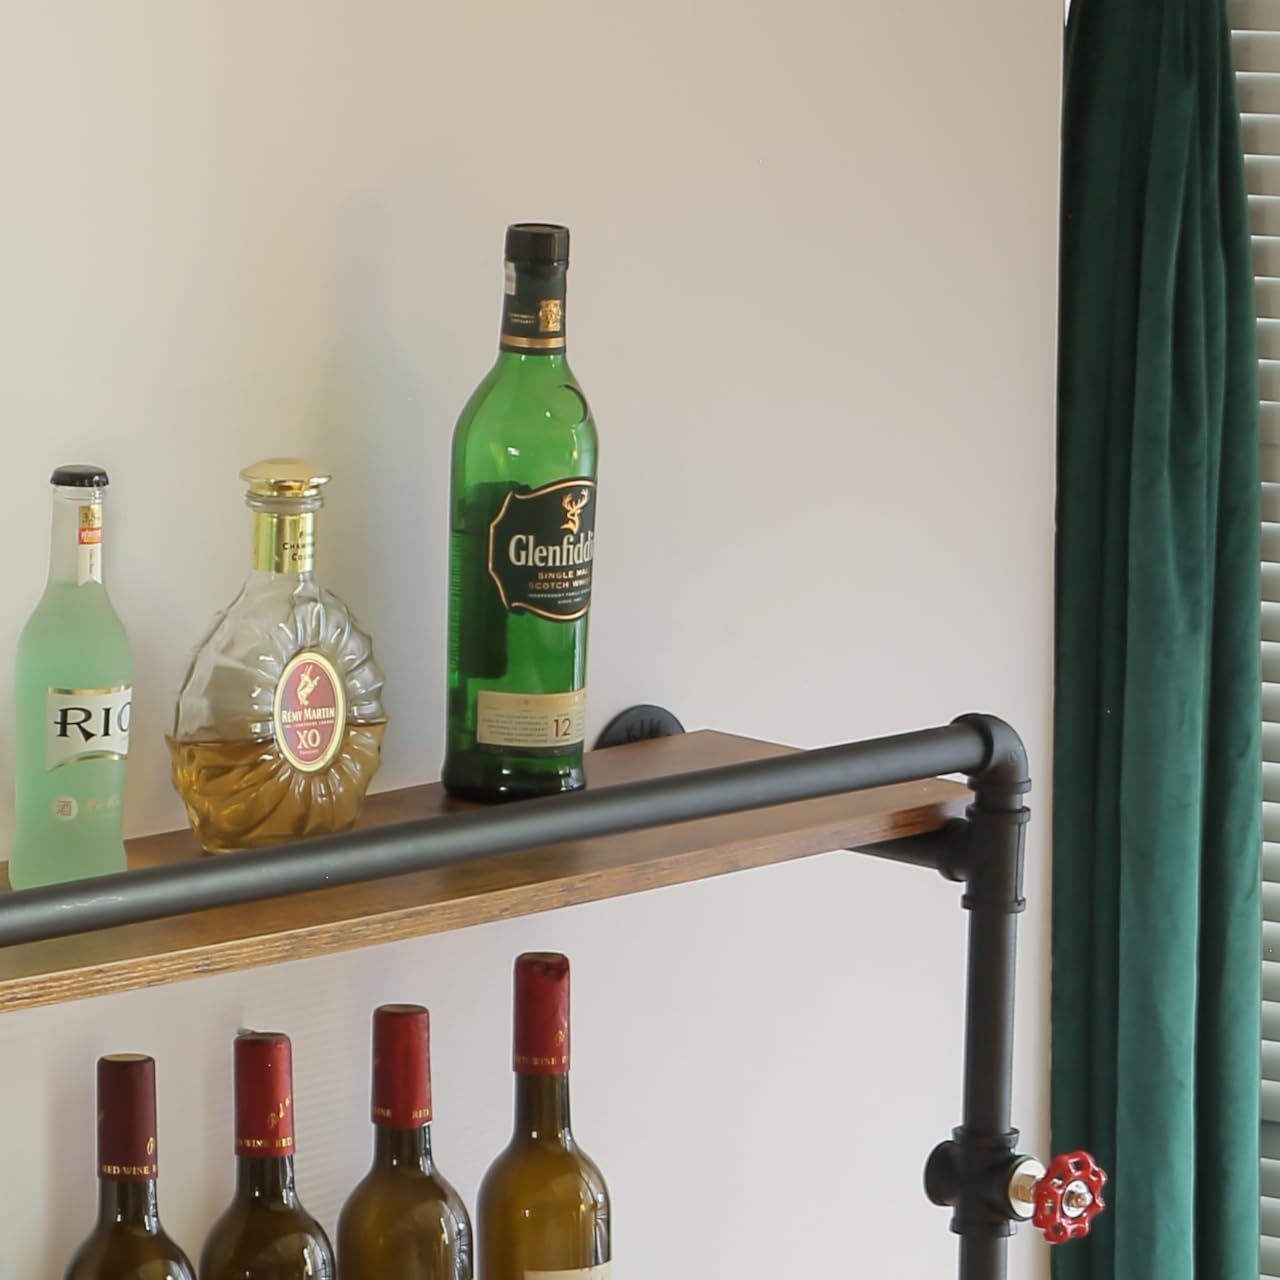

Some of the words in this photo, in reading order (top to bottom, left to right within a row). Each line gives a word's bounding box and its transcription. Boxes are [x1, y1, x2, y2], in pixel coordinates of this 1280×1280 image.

[537, 570, 574, 580] SINGLE
[528, 581, 569, 590] SCOTCH
[303, 707, 335, 721] MARTIN
[553, 717, 572, 737] 12
[296, 728, 321, 750] XO
[122, 1165, 150, 1175] WINE
